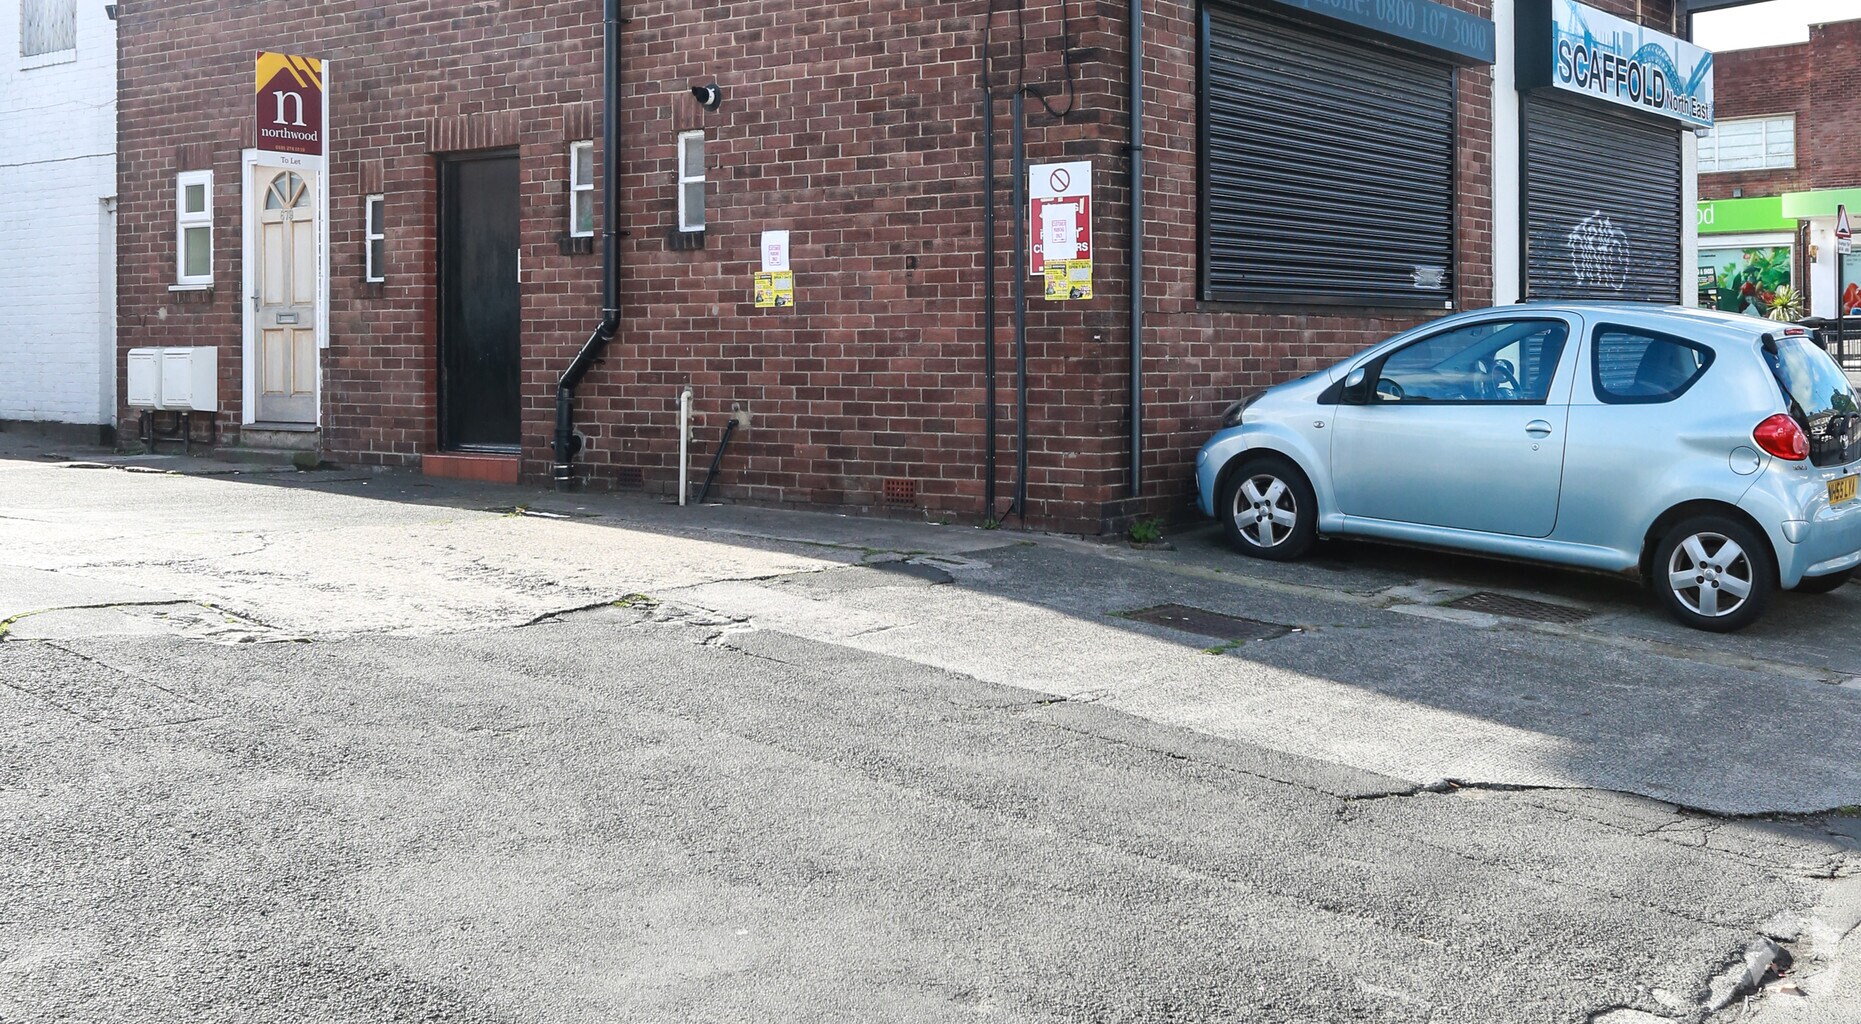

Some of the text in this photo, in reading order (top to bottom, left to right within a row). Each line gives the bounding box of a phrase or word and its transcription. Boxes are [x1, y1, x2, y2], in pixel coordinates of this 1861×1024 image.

[1422, 6, 1448, 39] 107
[1453, 17, 1486, 51] 3000
[1558, 39, 1665, 109] SCAFFOLD
[1665, 89, 1689, 116] North
[1691, 97, 1709, 121] East
[273, 90, 307, 127] n
[261, 127, 318, 142] northwood
[281, 156, 301, 165] To Let
